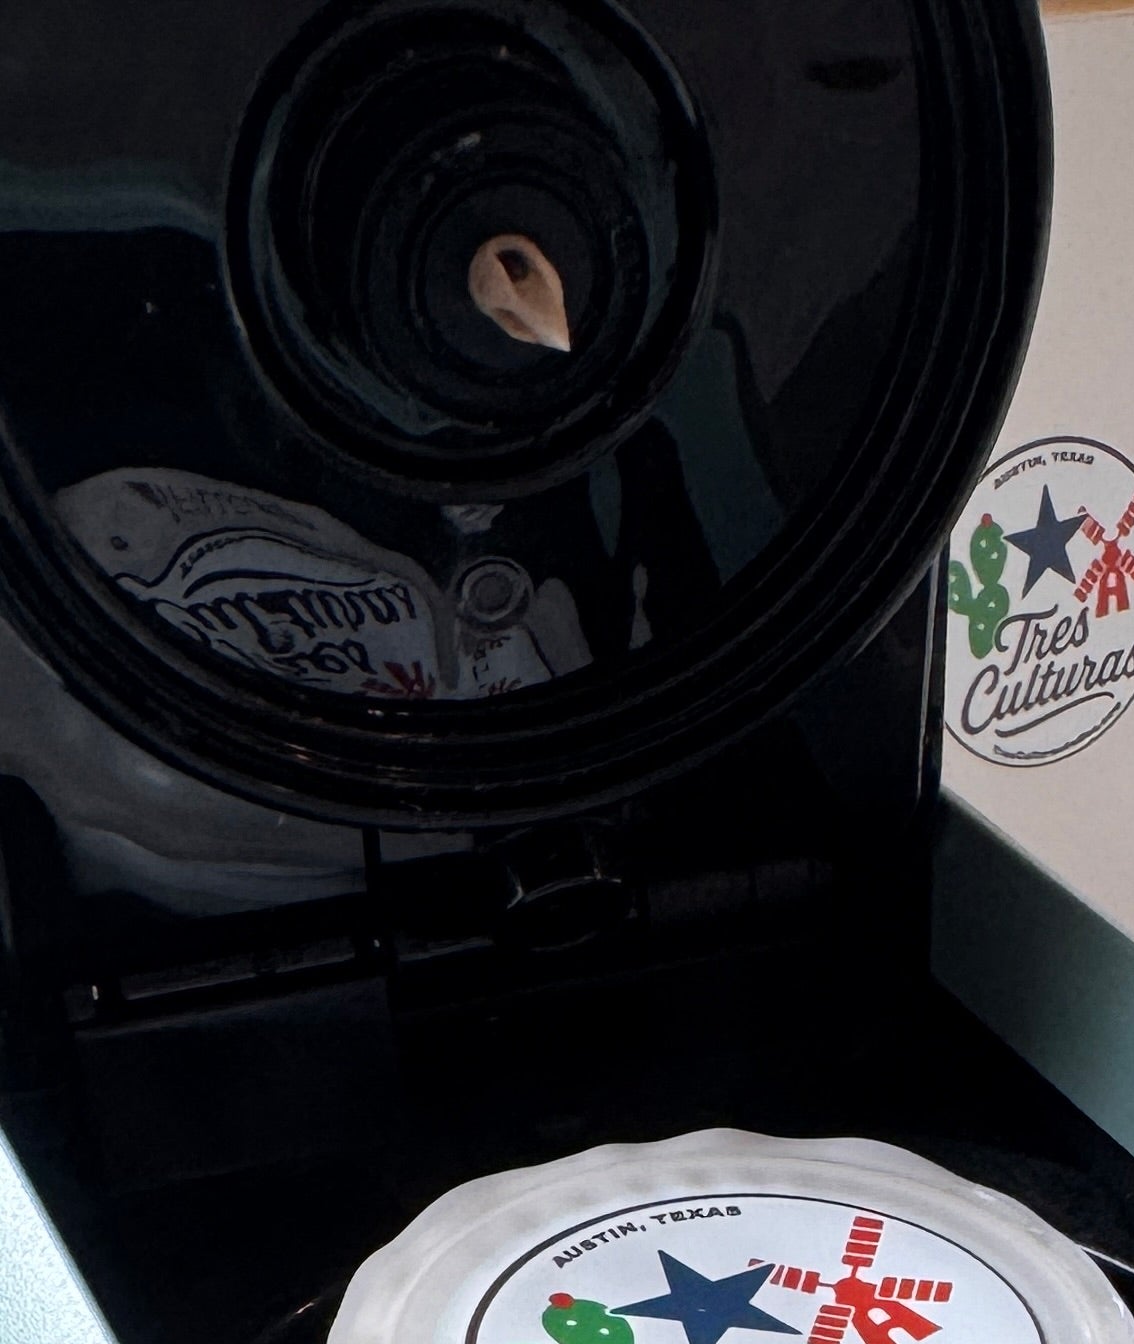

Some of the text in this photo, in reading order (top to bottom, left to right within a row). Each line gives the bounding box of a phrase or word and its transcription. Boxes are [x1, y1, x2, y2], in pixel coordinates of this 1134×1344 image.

[994, 604, 1090, 676] Tres
[553, 1206, 742, 1268] AUSTIN, TEXAS
